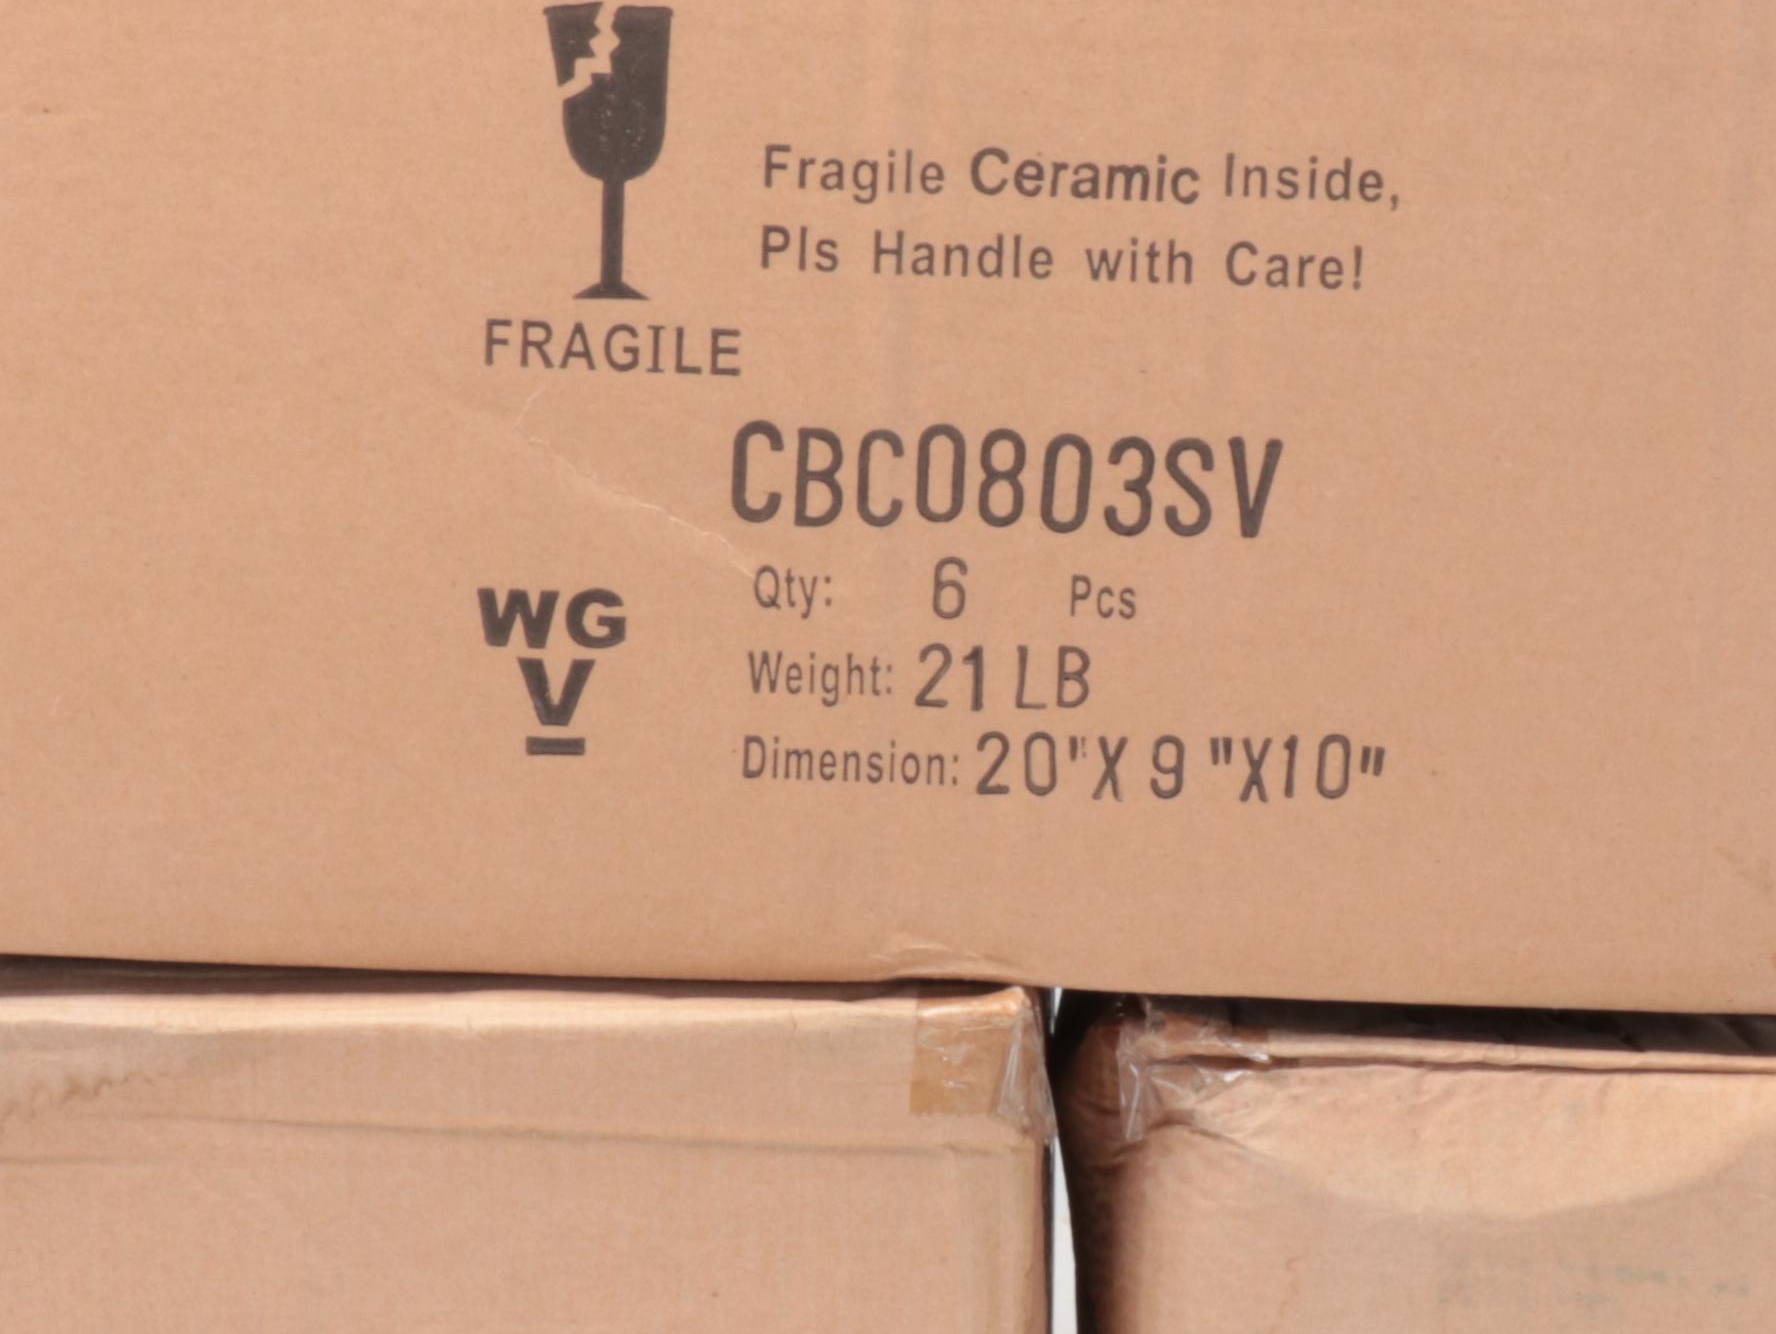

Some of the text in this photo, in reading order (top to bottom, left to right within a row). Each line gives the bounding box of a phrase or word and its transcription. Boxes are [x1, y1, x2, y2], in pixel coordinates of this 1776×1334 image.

[764, 143, 1399, 211] Fragile Ceramic Inside,
[760, 224, 1363, 291] Pls Handle with Care!
[484, 318, 741, 377] FRAGILE
[731, 419, 1284, 539] CBC0803SV
[477, 587, 627, 650] WG
[753, 555, 1137, 621] Qty: 6 Pcs
[517, 657, 596, 727] V
[747, 642, 1091, 713] Weight: 21 LB
[741, 734, 959, 786] Dimension:
